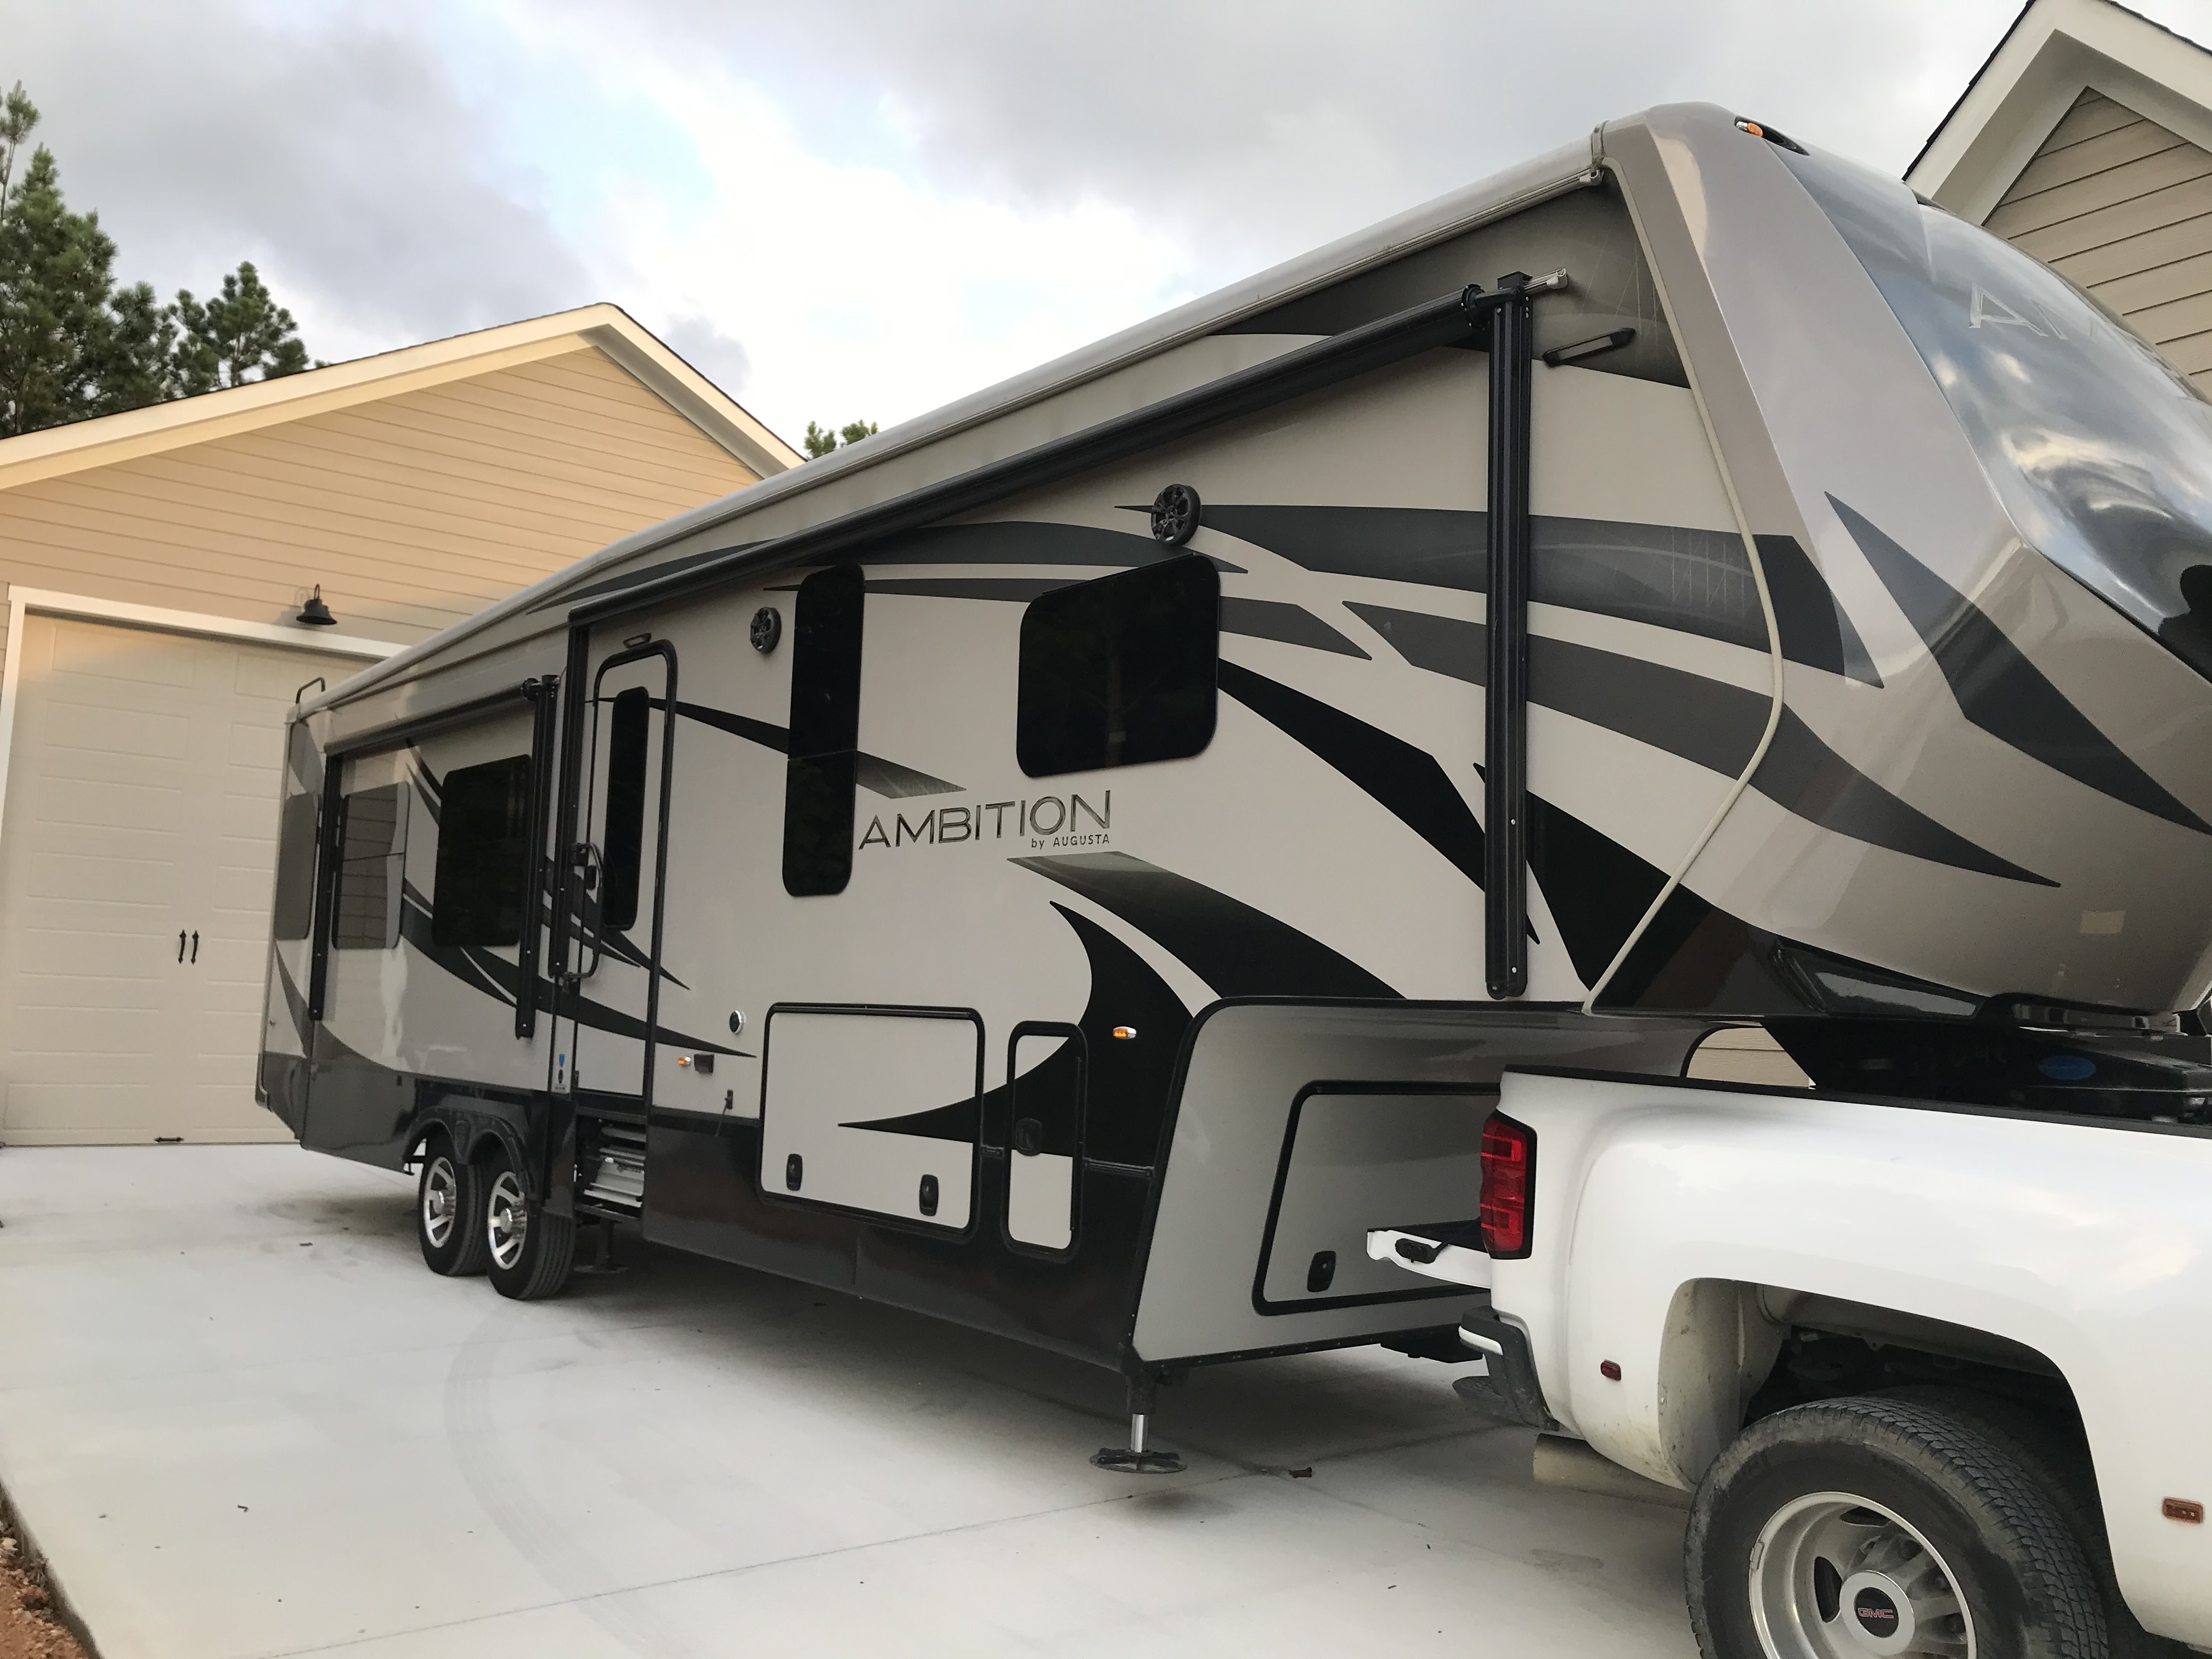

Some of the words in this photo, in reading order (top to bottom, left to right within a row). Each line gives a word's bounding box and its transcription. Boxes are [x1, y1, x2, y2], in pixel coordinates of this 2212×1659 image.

[858, 789, 1111, 850] AMBITION
[1031, 838, 1045, 850] by
[1052, 833, 1110, 847] AUGUSTA
[1857, 1607, 1894, 1619] GMC
